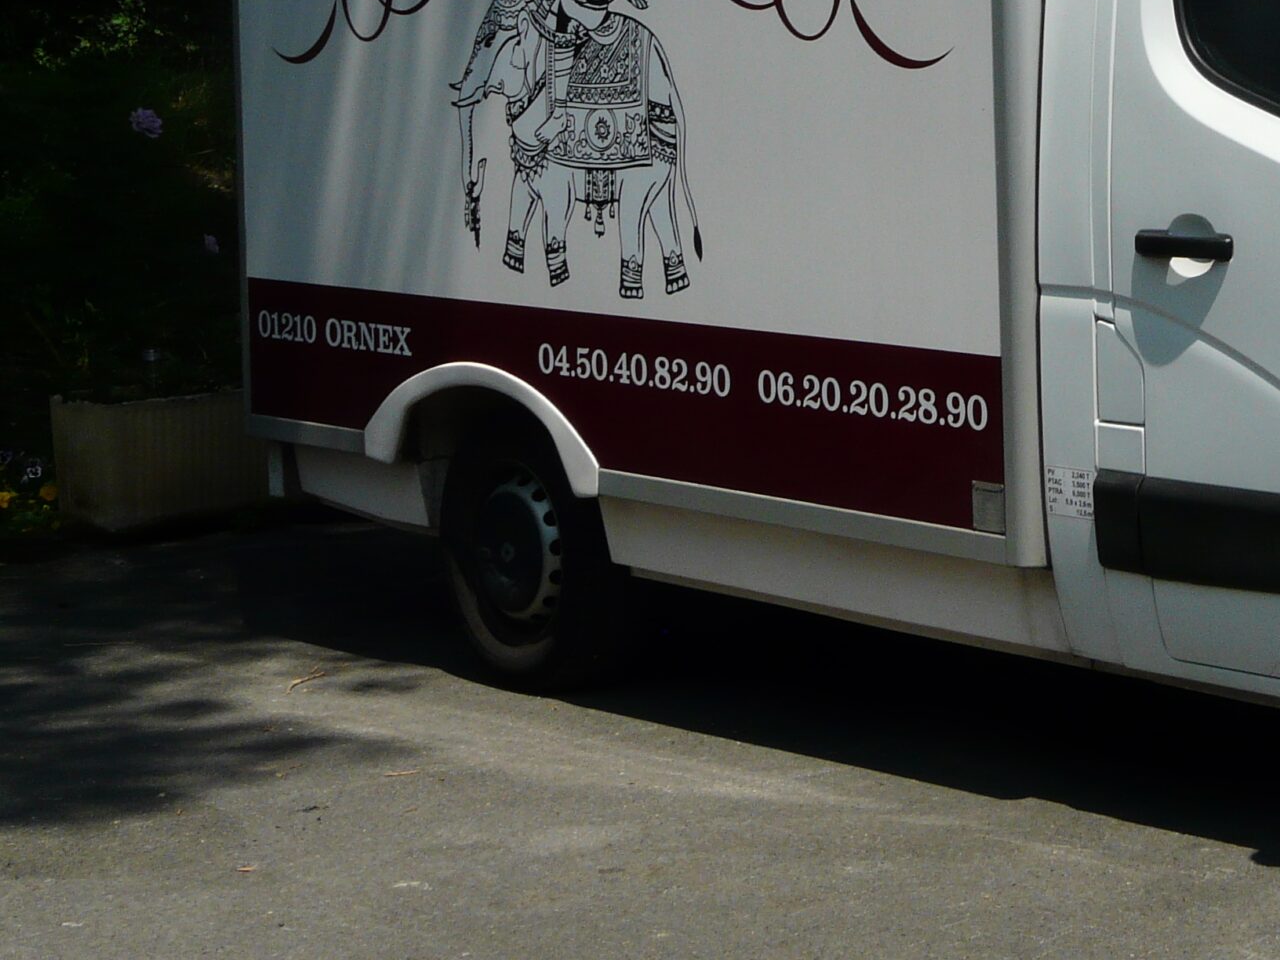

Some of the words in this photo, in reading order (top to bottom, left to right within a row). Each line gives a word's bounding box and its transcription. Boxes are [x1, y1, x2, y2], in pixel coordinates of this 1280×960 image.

[258, 310, 317, 344] 01210
[325, 318, 412, 356] ORNEX
[538, 343, 731, 397] 04.50.40.82.90
[758, 370, 988, 430] 06.20.20.28.90
